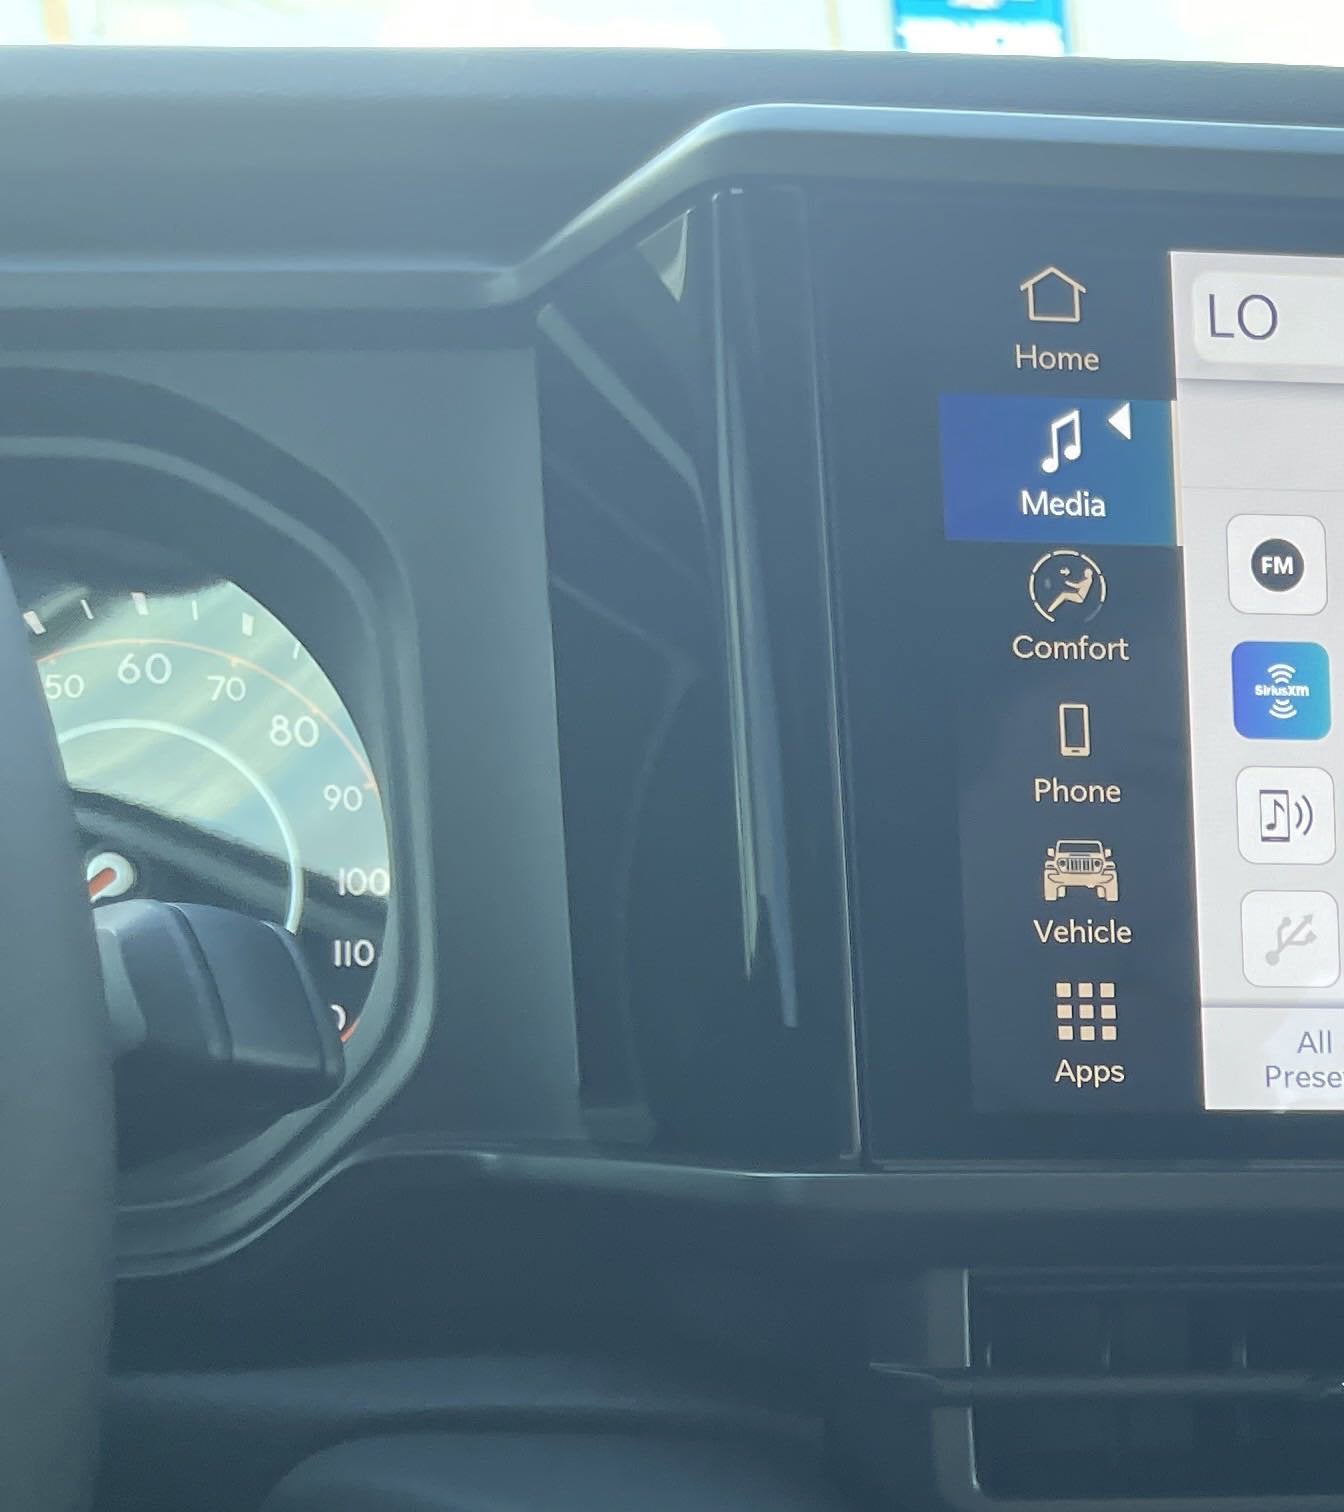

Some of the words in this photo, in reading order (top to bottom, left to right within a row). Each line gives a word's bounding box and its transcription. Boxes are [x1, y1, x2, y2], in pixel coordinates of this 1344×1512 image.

[1207, 293, 1278, 341] LO
[1015, 345, 1100, 371] Home
[1021, 491, 1106, 518] Media
[1261, 556, 1294, 576] FM
[1012, 635, 1129, 661] Comfort
[118, 653, 172, 685] 60
[45, 674, 84, 700] 50
[207, 675, 246, 702] 70
[269, 715, 319, 748] 80
[324, 784, 362, 812] 90
[1034, 778, 1121, 804] Phone
[338, 869, 390, 896] 100
[1033, 919, 1132, 945] Vehicle
[334, 940, 374, 966] 110
[1297, 1031, 1332, 1054] All
[1055, 1060, 1125, 1090] Apps
